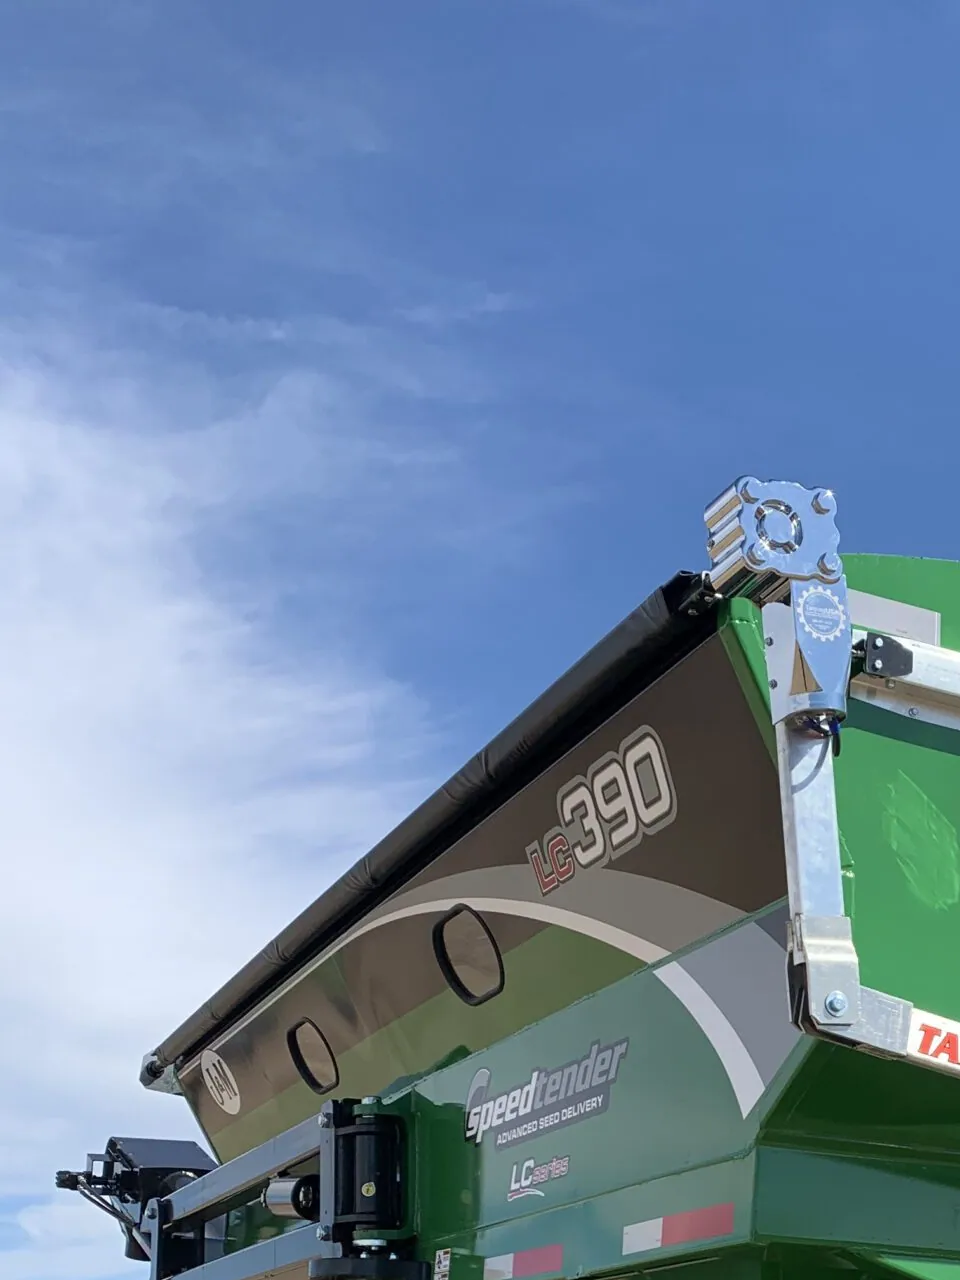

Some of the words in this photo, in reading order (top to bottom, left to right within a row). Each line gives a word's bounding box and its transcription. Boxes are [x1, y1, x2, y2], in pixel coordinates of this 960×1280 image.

[205, 1058, 238, 1106] J&M
[496, 1120, 538, 1146] ADVANCED
[538, 1111, 560, 1130] SEED
[561, 1094, 604, 1121] DELIVERY
